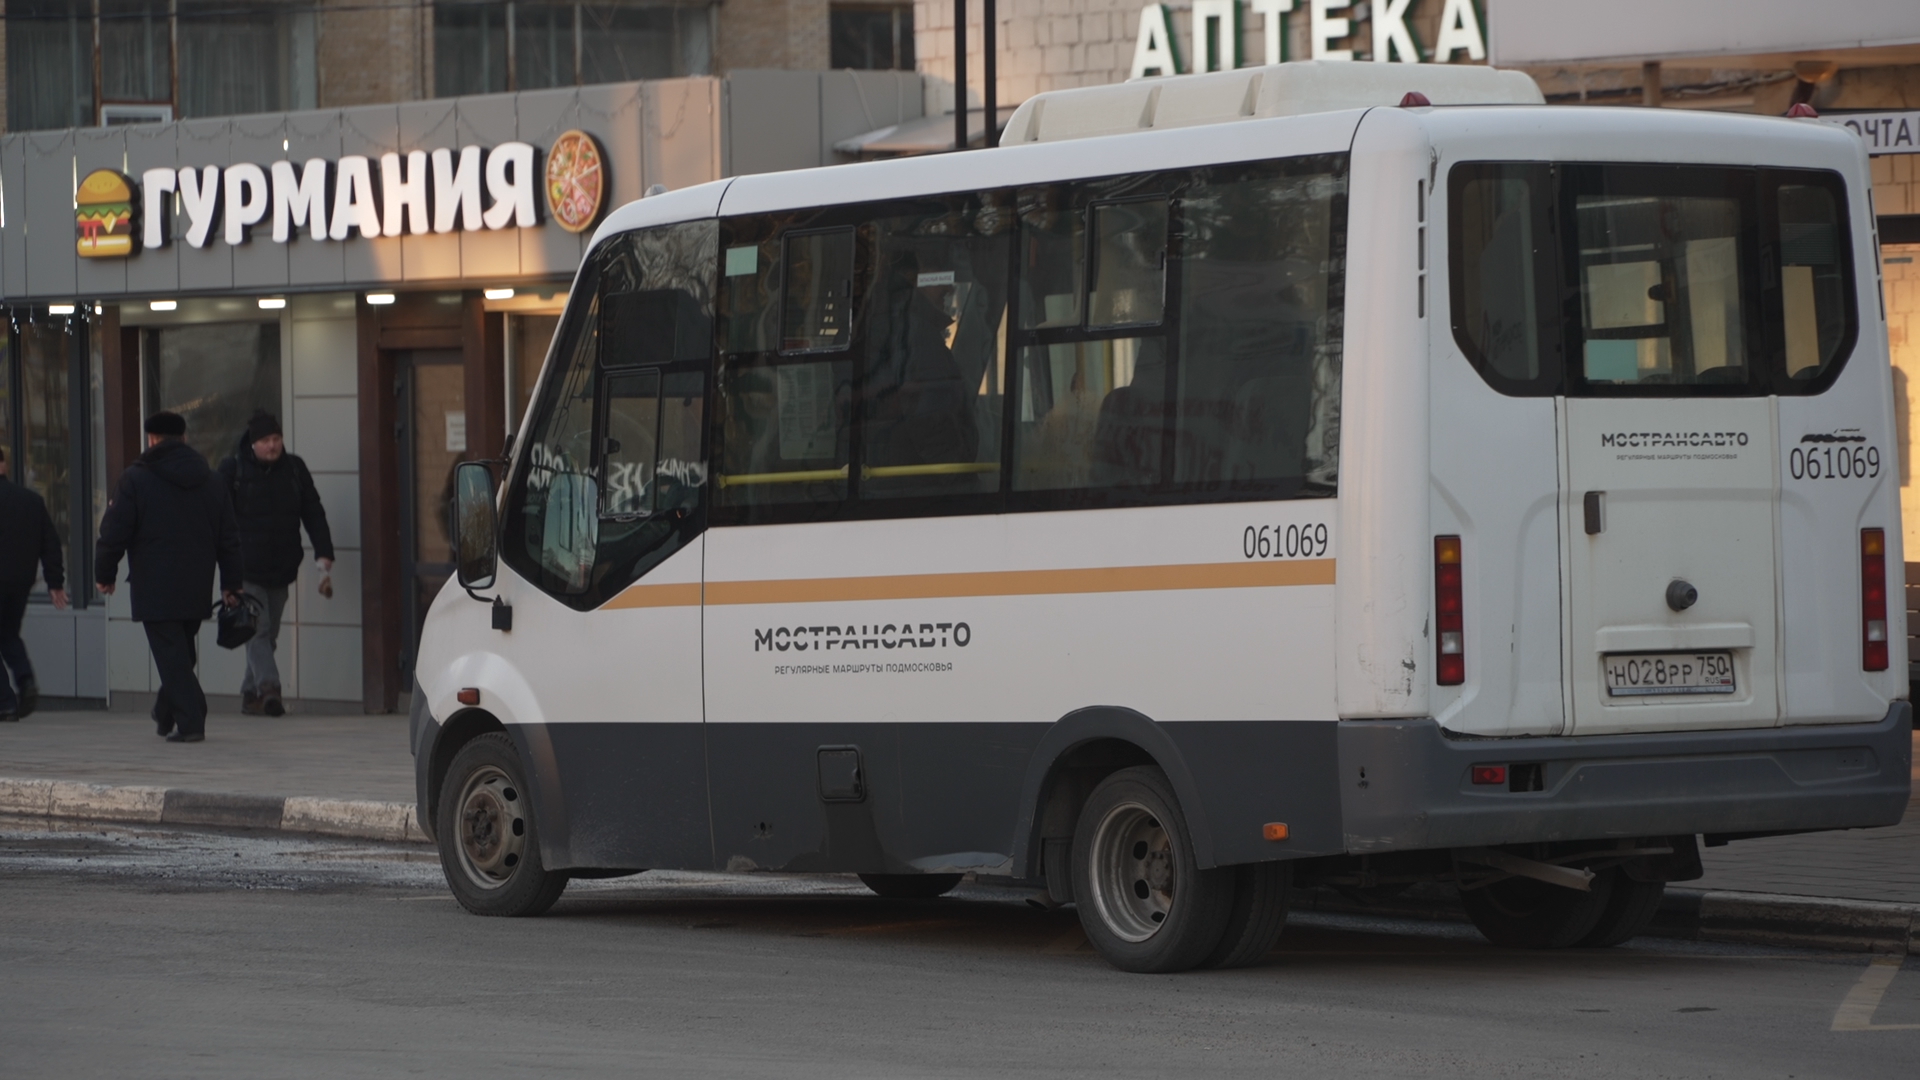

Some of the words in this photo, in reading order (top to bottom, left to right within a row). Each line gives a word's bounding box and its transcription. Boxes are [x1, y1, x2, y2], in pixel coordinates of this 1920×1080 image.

[1130, 0, 1485, 78] АПТЕКА
[142, 141, 537, 249] ГУРМАНИЯ
[1601, 432, 1749, 447] МОСТРАНСАВТО
[1790, 446, 1880, 480] 061069
[1243, 523, 1328, 559] 061069
[754, 621, 971, 652] МОСТРАНСАВТО
[774, 664, 830, 675] РЕГУЛЯРНЫЕ
[832, 664, 884, 674] МАРШРУТЫ
[886, 662, 953, 673] ПОДМОСКОВЬЯ
[1697, 656, 1726, 677] 750
[1704, 676, 1720, 684] RUS
